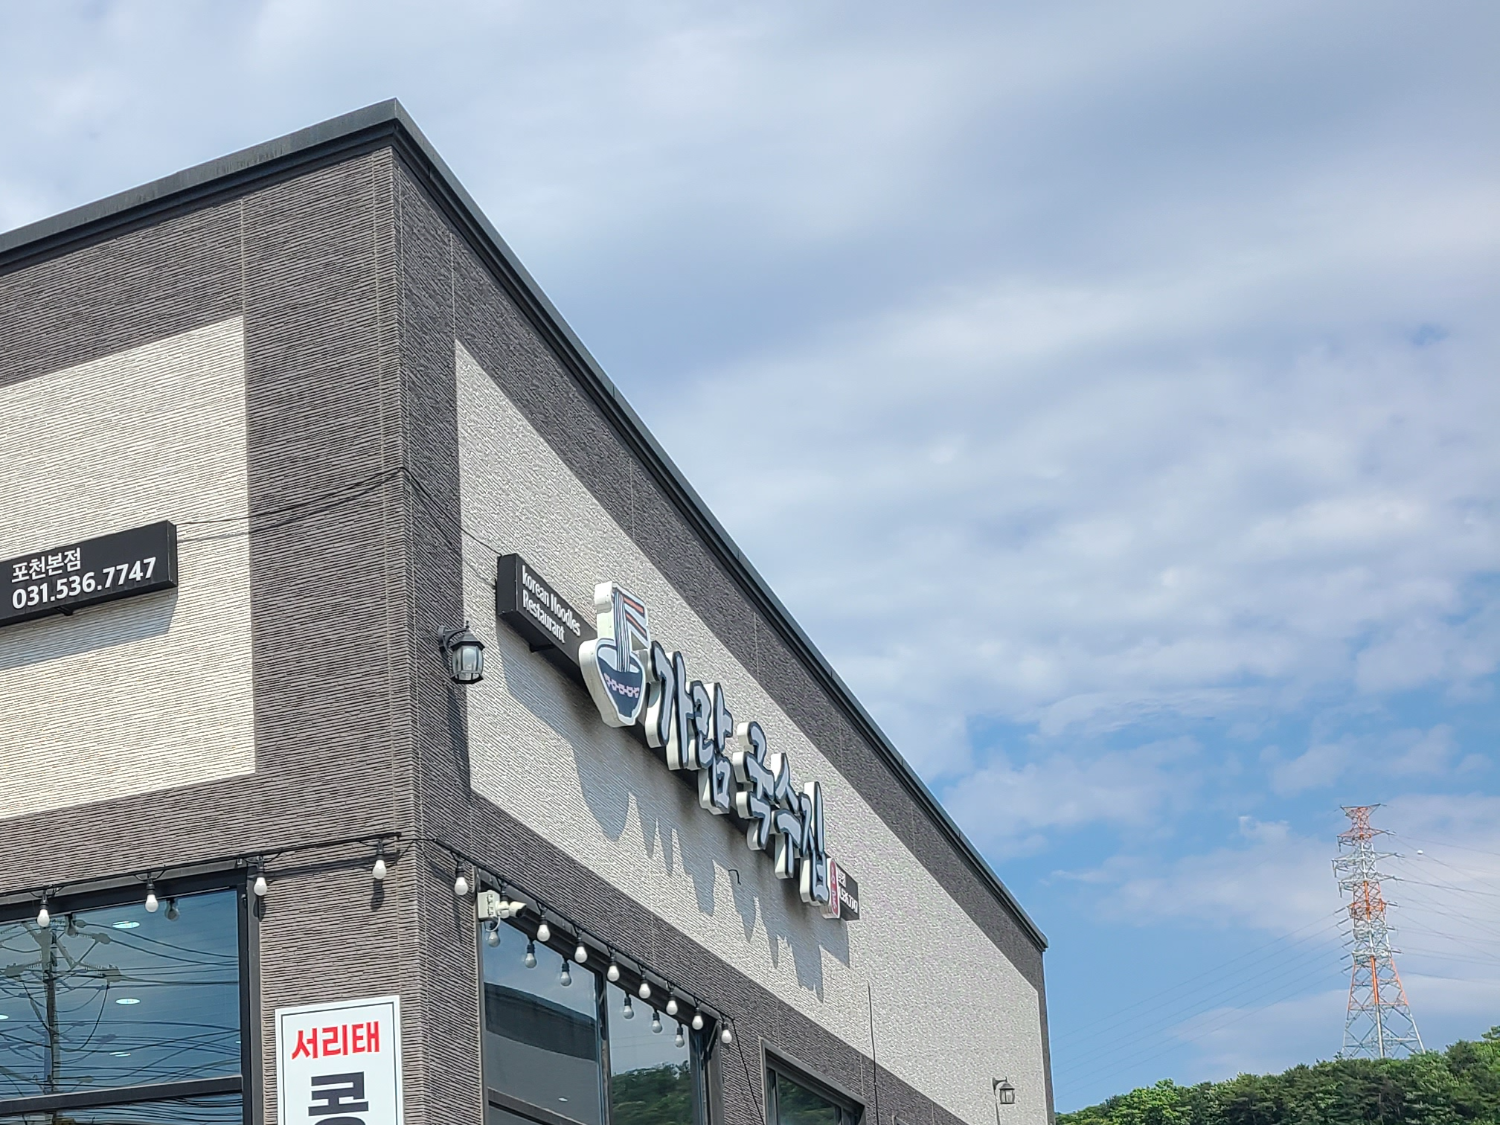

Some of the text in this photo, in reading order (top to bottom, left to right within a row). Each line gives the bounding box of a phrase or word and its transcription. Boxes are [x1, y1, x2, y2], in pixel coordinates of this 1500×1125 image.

[11, 547, 82, 583] 포천본점
[12, 556, 157, 610] 031.536.7747
[522, 564, 581, 637] korean Noodles
[522, 589, 566, 644] Restaurant
[649, 641, 829, 904] 가람 국수집
[290, 1020, 381, 1061] 서리태
